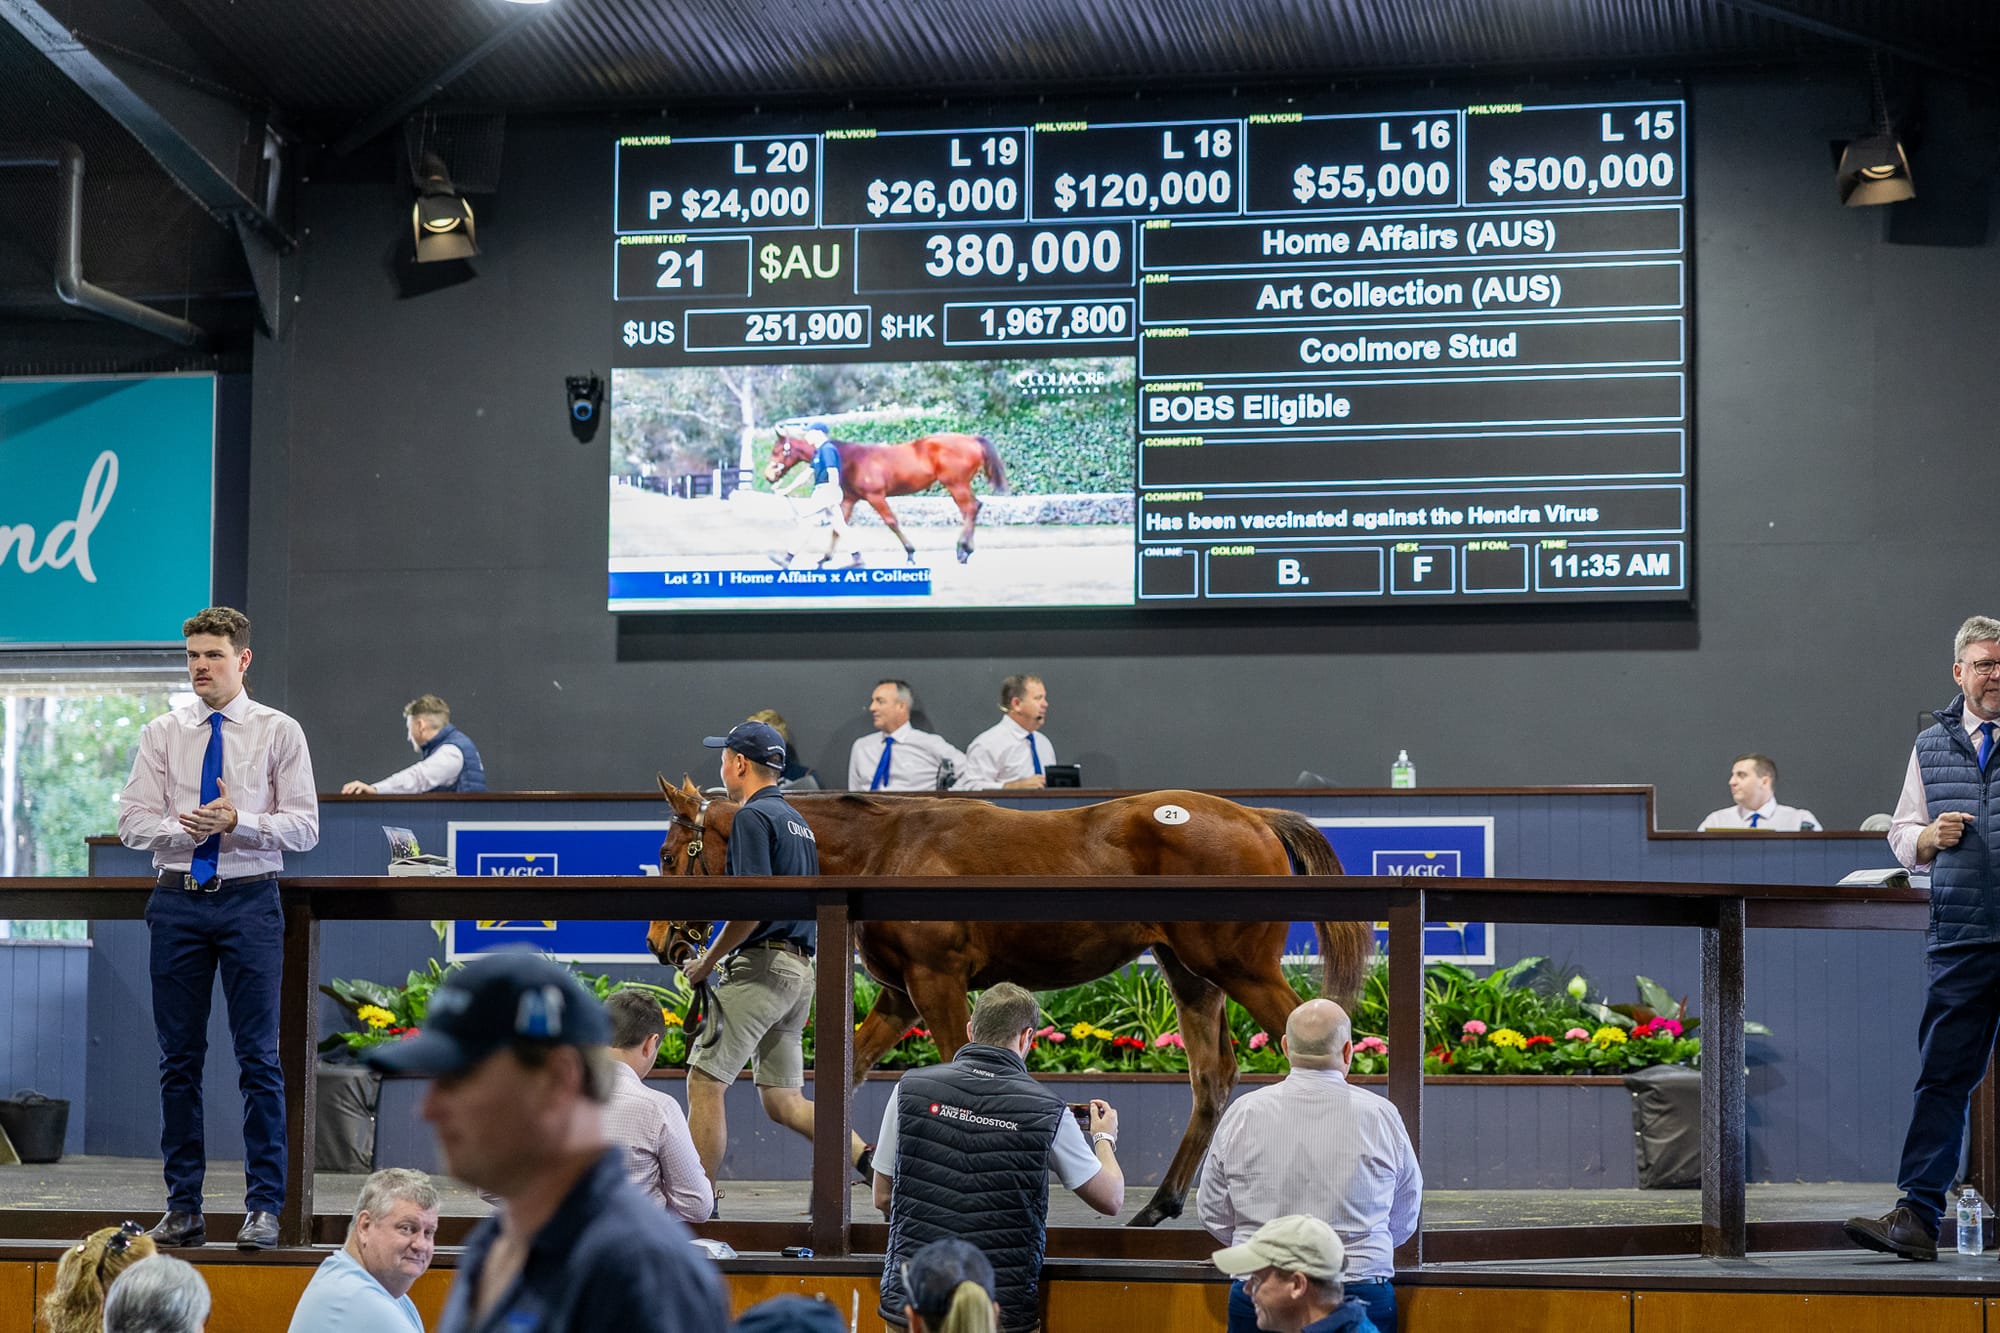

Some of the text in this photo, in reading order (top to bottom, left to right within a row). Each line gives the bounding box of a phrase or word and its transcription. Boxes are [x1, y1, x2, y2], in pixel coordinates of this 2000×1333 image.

[1381, 120, 1450, 150] L 16
[1603, 111, 1674, 141] L 15
[735, 142, 808, 173] L 20
[952, 137, 1017, 166] L 19
[1164, 129, 1231, 159] L 18
[1293, 162, 1449, 203] $55,000
[1489, 153, 1673, 196] $500,000
[650, 187, 809, 222] P $24,000
[867, 178, 1017, 218] $26,000
[1055, 170, 1230, 212] $120,000
[621, 234, 687, 245] CURRENT LOT
[1263, 220, 1556, 255] Home Affairs (AUS)
[657, 250, 703, 287] 21
[760, 243, 839, 283] $AU
[926, 230, 1120, 281] 380,000
[1145, 274, 1169, 284] DAM
[1256, 275, 1561, 310] Art Collection (AUS)
[623, 320, 674, 347] $US
[746, 312, 862, 345] 251,900
[881, 314, 935, 340] $HK
[981, 305, 1126, 340] 1,967,800
[1300, 332, 1516, 363] Coolmore Stud
[1150, 393, 1350, 425] BOBS Eligible
[1146, 504, 1599, 530] Has been vaccinated against the Hendra Virus
[1144, 547, 1183, 557] ONLINE
[1210, 546, 1255, 556] COLOUR
[1396, 543, 1419, 552] SEX
[1468, 541, 1510, 551] IN FOAL
[1541, 540, 1567, 549] TIME
[664, 573, 687, 584] Lot
[692, 573, 710, 584] 21
[730, 572, 773, 584] Home
[777, 571, 826, 583] Affairs
[831, 574, 840, 582] x
[845, 570, 868, 582] Art
[1279, 559, 1309, 584] B.
[1414, 556, 1433, 582] F
[1551, 554, 1669, 577] 11:35 AM
[1164, 810, 1177, 819] 21
[491, 867, 544, 876] MAGIC
[1388, 865, 1446, 877] MAGIC
[940, 1108, 1018, 1131] ANZ BLOODSTOCK
